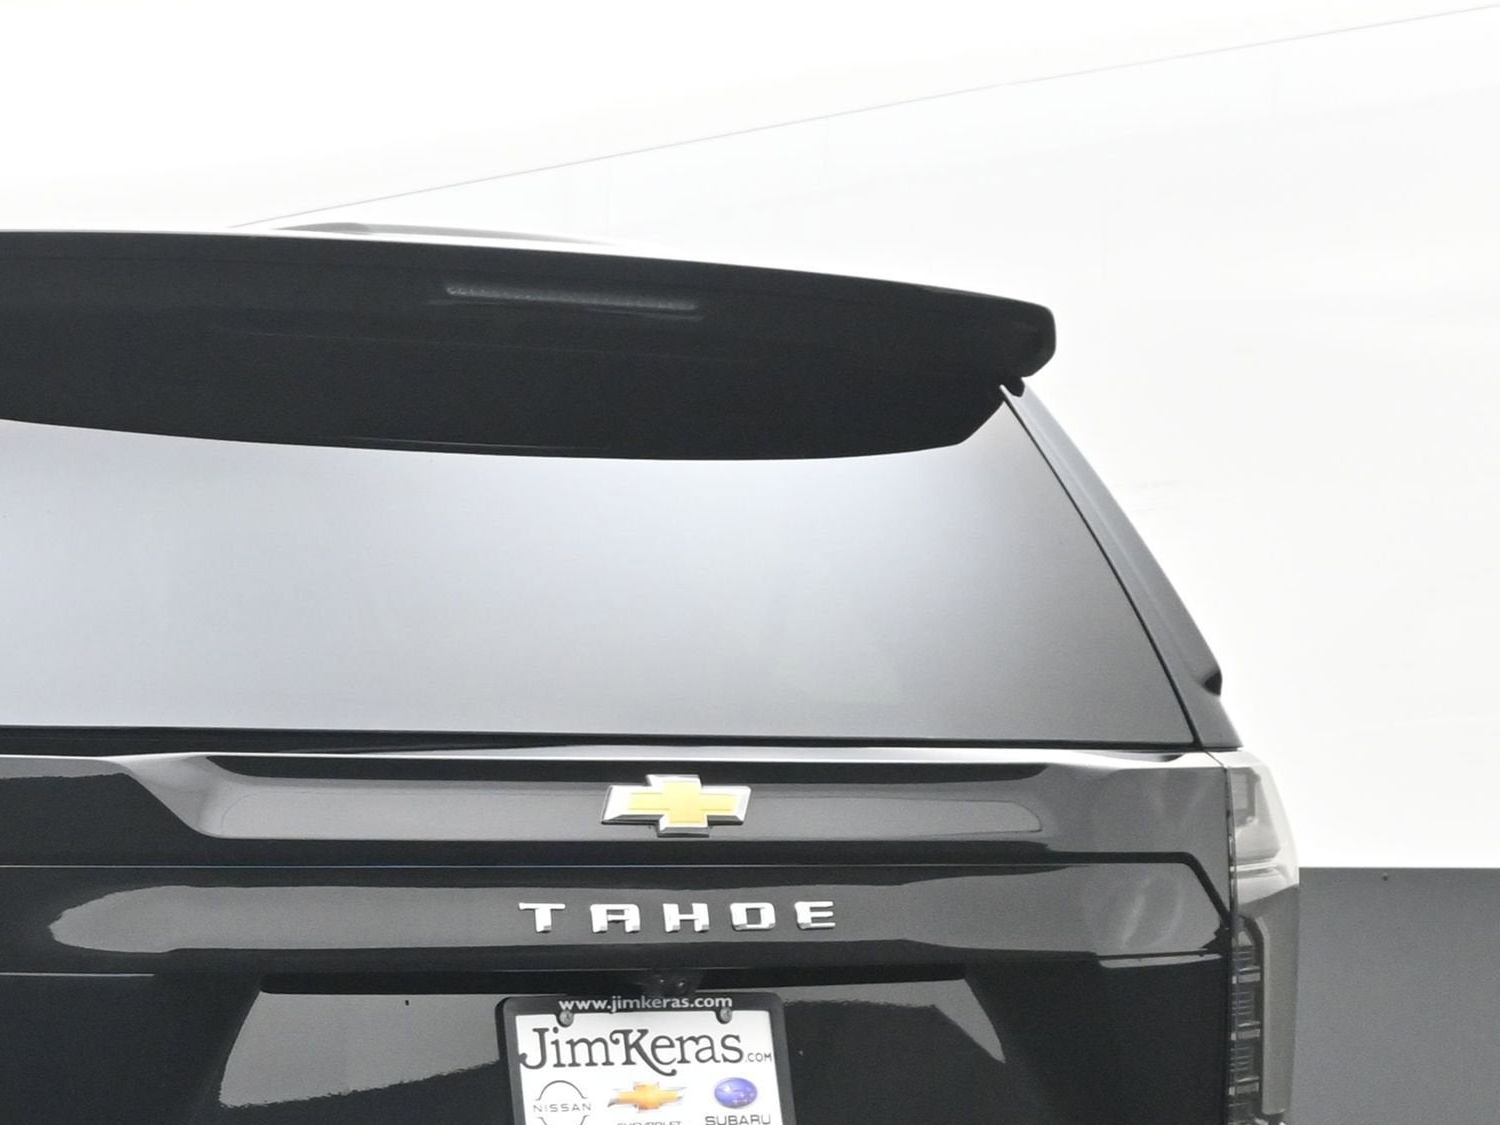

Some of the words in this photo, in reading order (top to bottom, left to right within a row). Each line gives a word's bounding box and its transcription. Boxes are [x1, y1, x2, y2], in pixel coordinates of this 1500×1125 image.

[518, 901, 836, 933] TAHOE
[558, 995, 733, 1013] www.jimkeras.com
[533, 1102, 592, 1113] NISSAN
